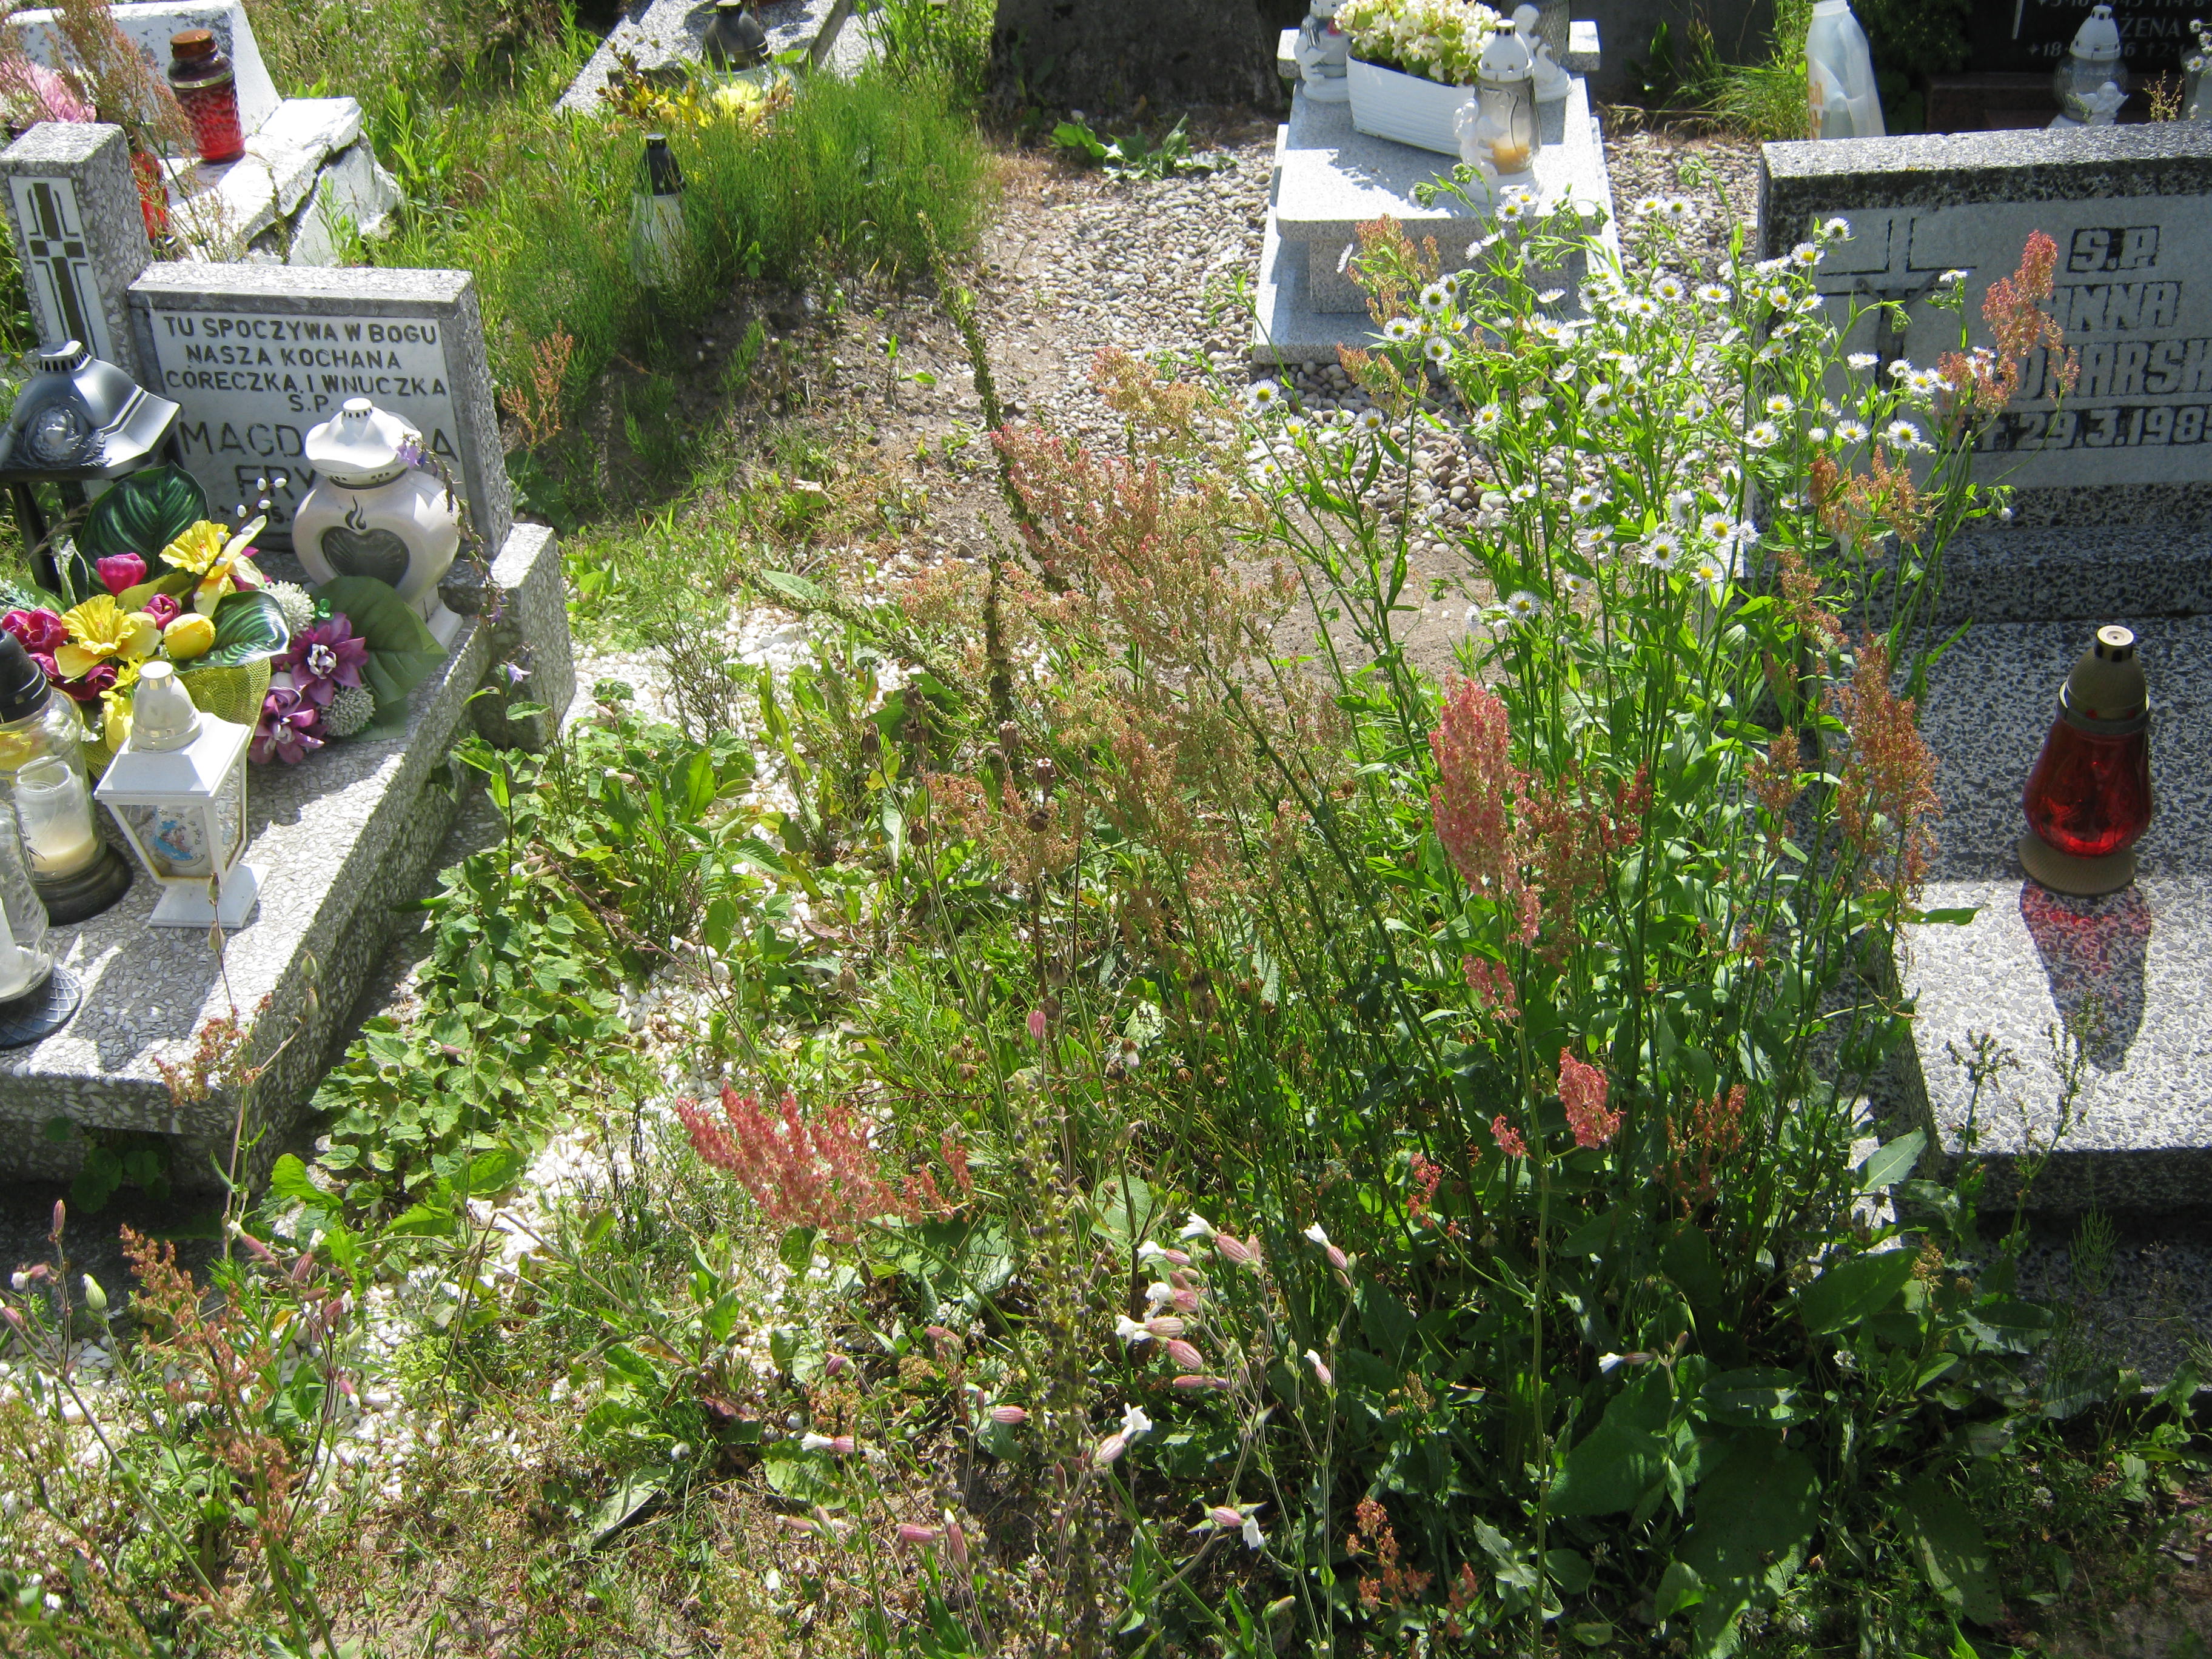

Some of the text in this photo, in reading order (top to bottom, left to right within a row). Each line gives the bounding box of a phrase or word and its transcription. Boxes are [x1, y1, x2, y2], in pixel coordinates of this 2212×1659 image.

[2036, 281, 2182, 332] ANNA
[163, 316, 437, 344] TU SPOCZYWA W BOGU
[186, 344, 401, 369] NASZA KOCHANA
[307, 374, 314, 393] I
[321, 374, 446, 396] WNUCZKA
[178, 421, 459, 462] MAGDA
